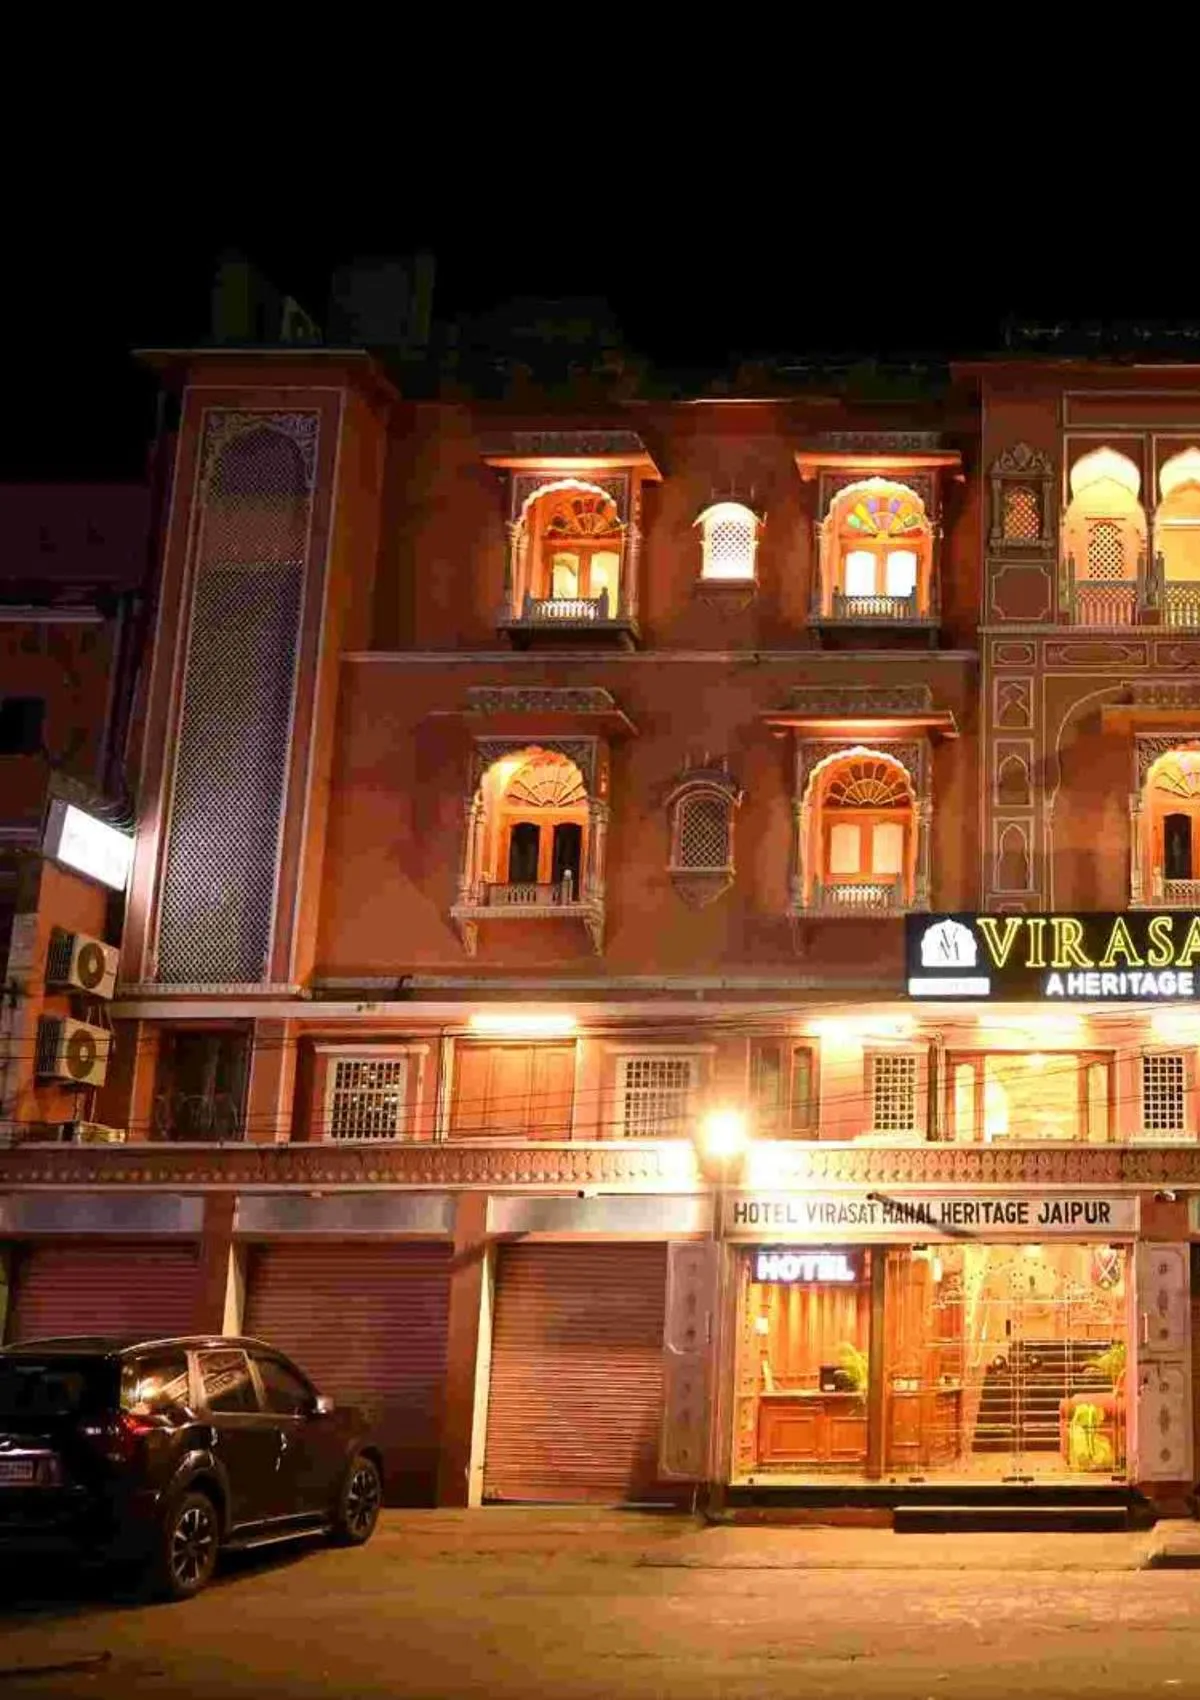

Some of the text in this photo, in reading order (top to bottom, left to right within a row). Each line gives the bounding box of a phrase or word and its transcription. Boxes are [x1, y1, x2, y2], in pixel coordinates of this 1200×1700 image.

[1045, 972, 1064, 996] A
[1067, 971, 1194, 996] HERITAGE
[733, 1201, 1111, 1225] HOTEL VIRASAT MAHAL HERITAGE JAIPUR
[756, 1252, 856, 1281] HOTEL
